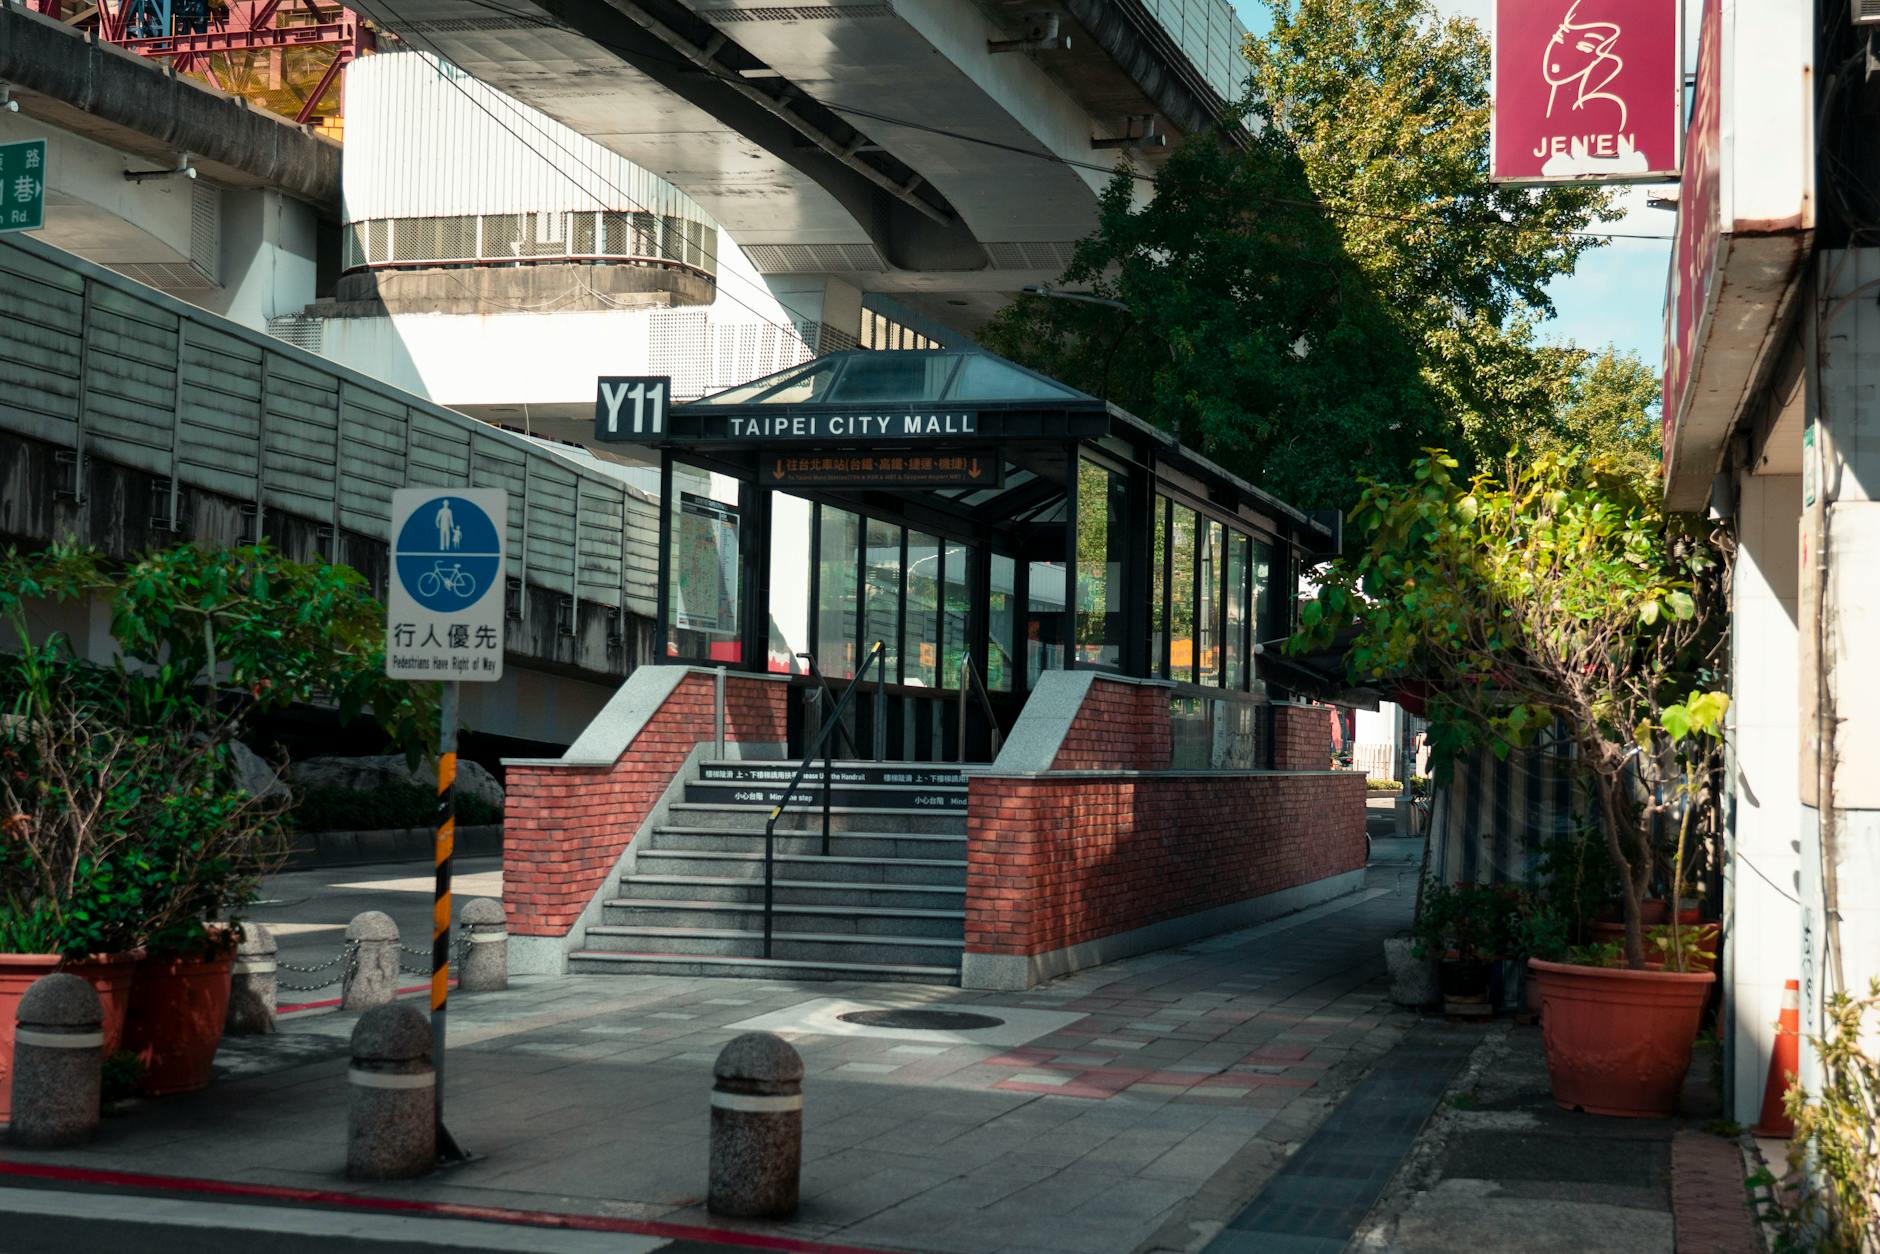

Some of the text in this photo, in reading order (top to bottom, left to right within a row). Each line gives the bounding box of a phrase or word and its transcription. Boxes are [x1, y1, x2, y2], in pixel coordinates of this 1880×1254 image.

[1533, 133, 1635, 158] JEN'EN
[600, 382, 664, 433] Y11
[731, 414, 975, 436] TAIPEI CITY MALL
[394, 623, 497, 649] 行人優先
[393, 655, 496, 674] Pedestrians Have Right of Way
[734, 791, 764, 801] 小心台階
[798, 794, 813, 803] step
[914, 796, 945, 805] 小心台階
